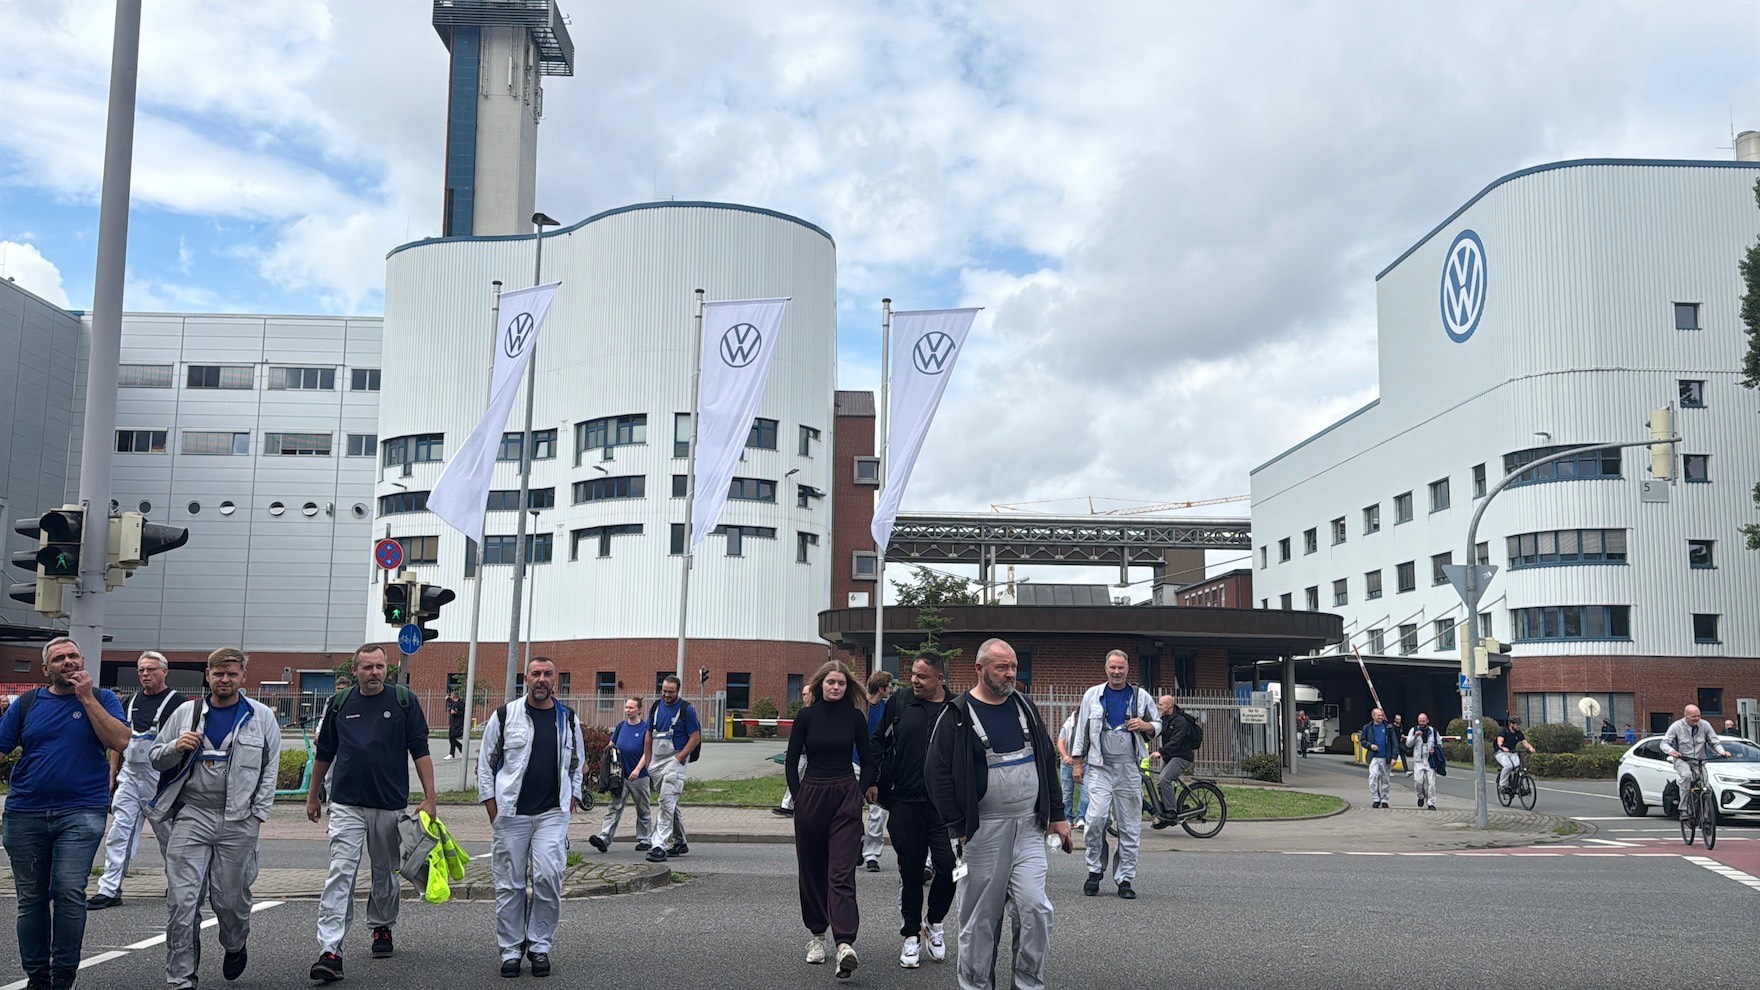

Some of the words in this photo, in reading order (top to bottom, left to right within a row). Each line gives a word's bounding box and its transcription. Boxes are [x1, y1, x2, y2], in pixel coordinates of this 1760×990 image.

[1443, 236, 1484, 336] VW
[720, 323, 762, 366] VW
[914, 332, 955, 373] VW
[1644, 482, 1650, 492] 5
